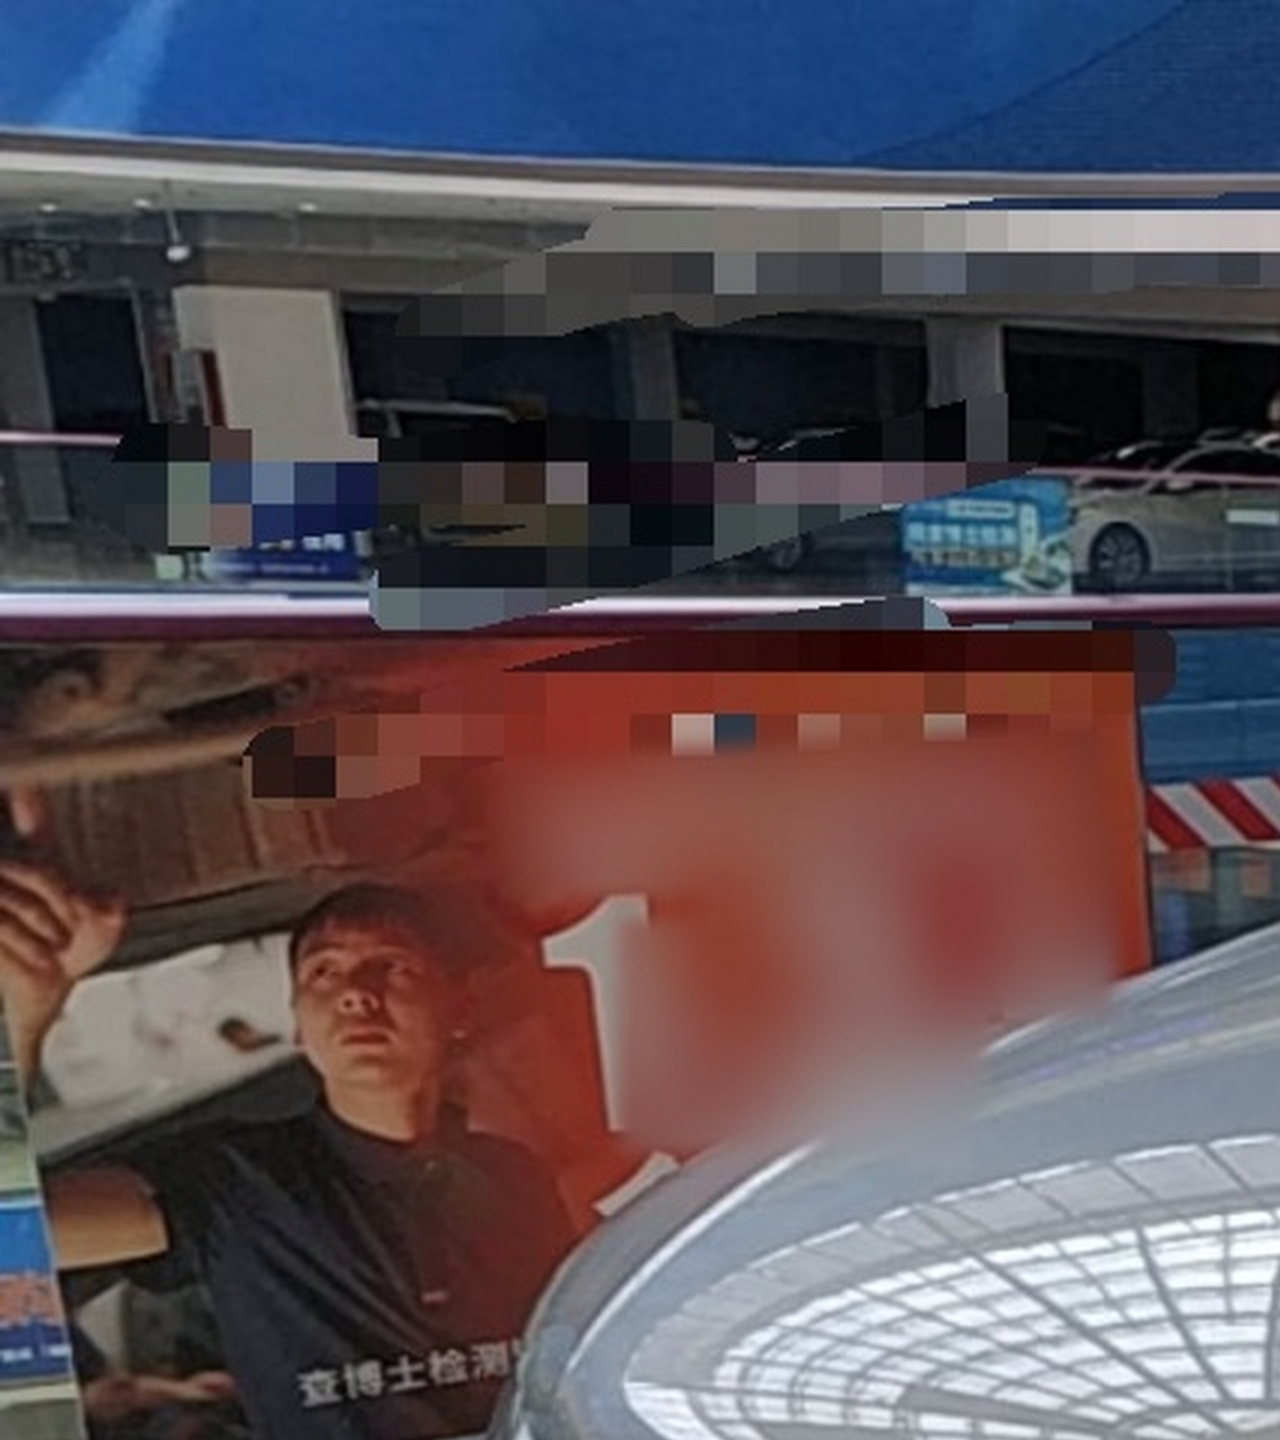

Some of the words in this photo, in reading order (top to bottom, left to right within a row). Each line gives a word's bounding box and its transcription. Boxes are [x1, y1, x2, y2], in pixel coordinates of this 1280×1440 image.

[298, 1339, 520, 1408] 查博士检测
